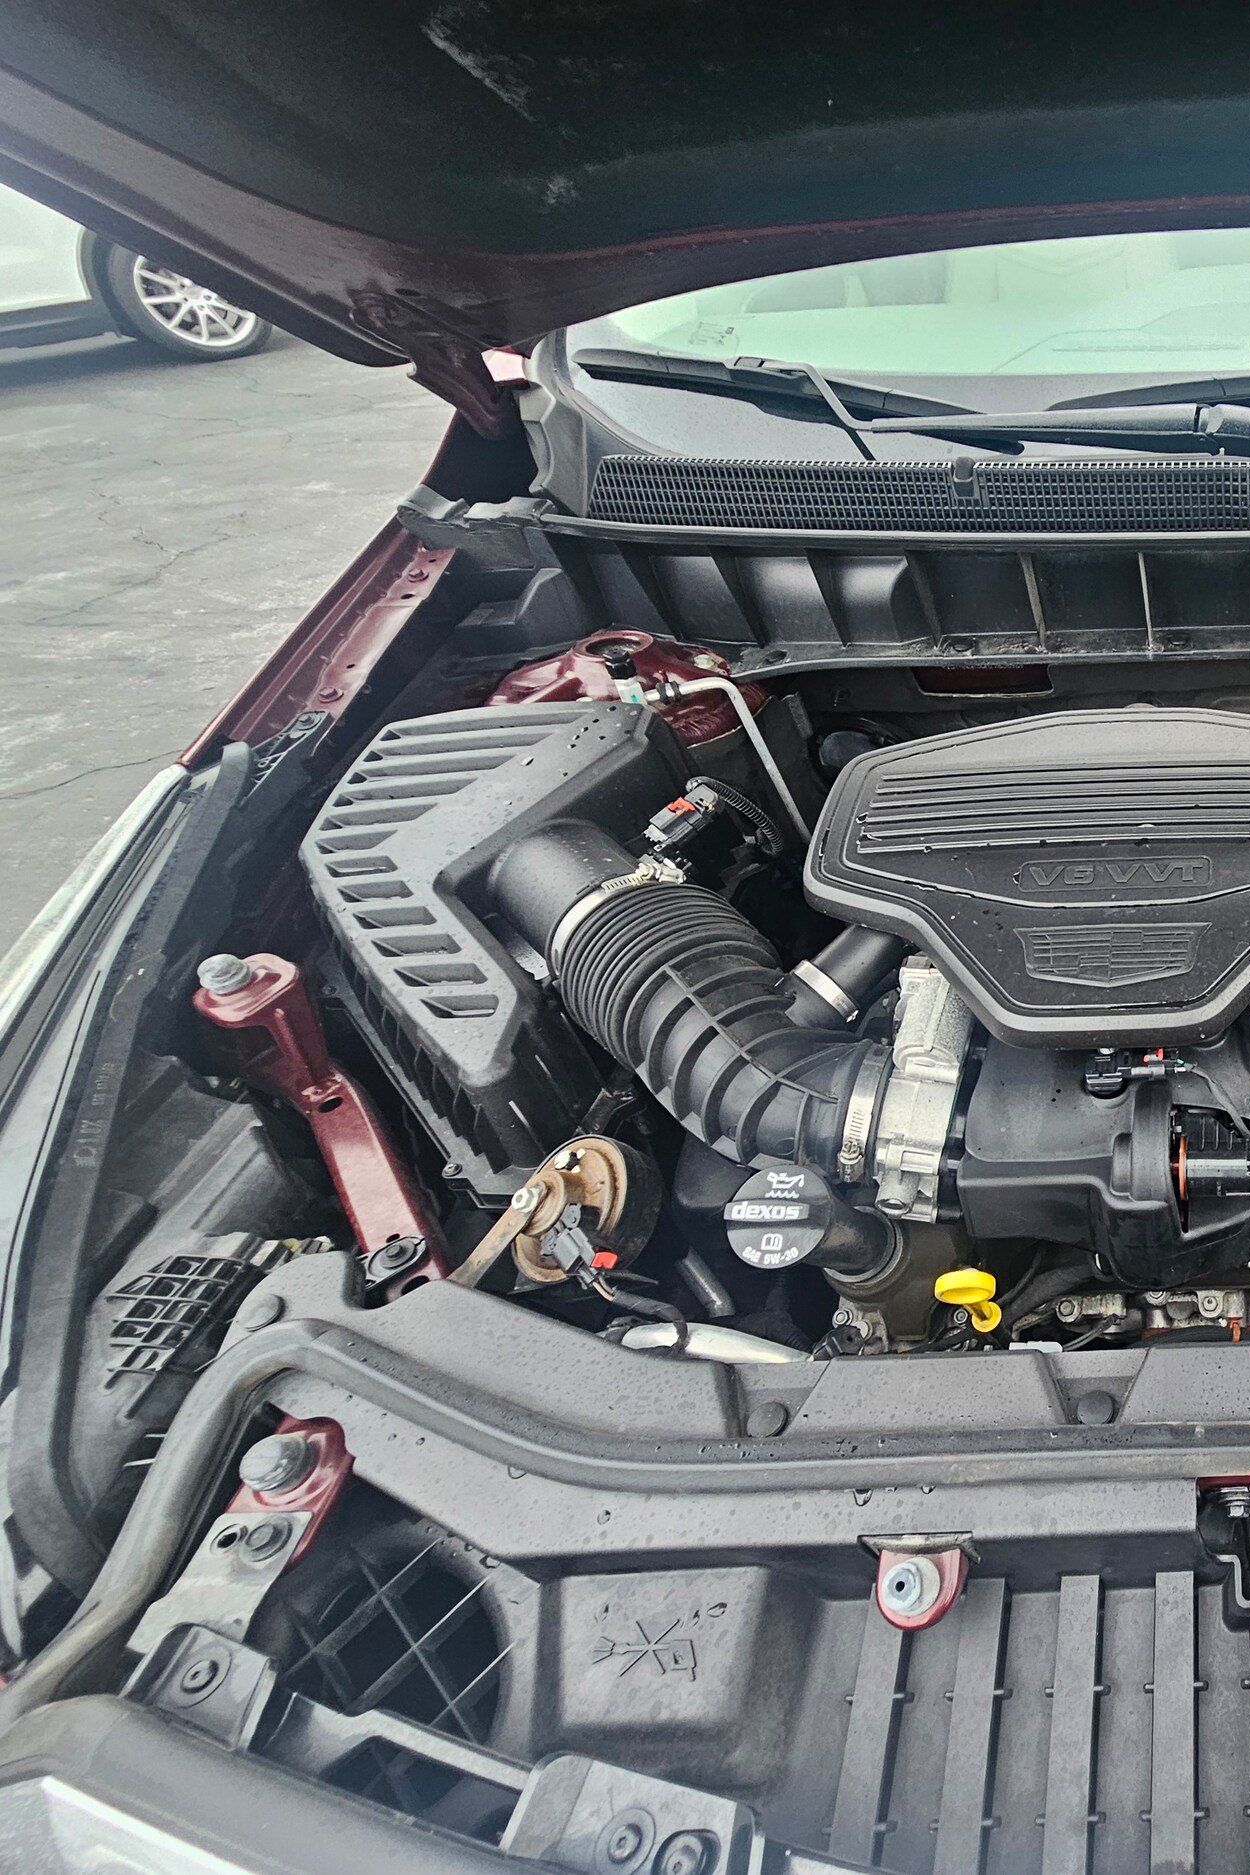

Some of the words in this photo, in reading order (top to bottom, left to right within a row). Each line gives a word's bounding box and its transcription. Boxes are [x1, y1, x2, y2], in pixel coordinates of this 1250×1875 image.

[1029, 865, 1095, 887] V6
[1106, 862, 1203, 884] VVT
[731, 1200, 800, 1220] dexos
[742, 1246, 761, 1263] SAE
